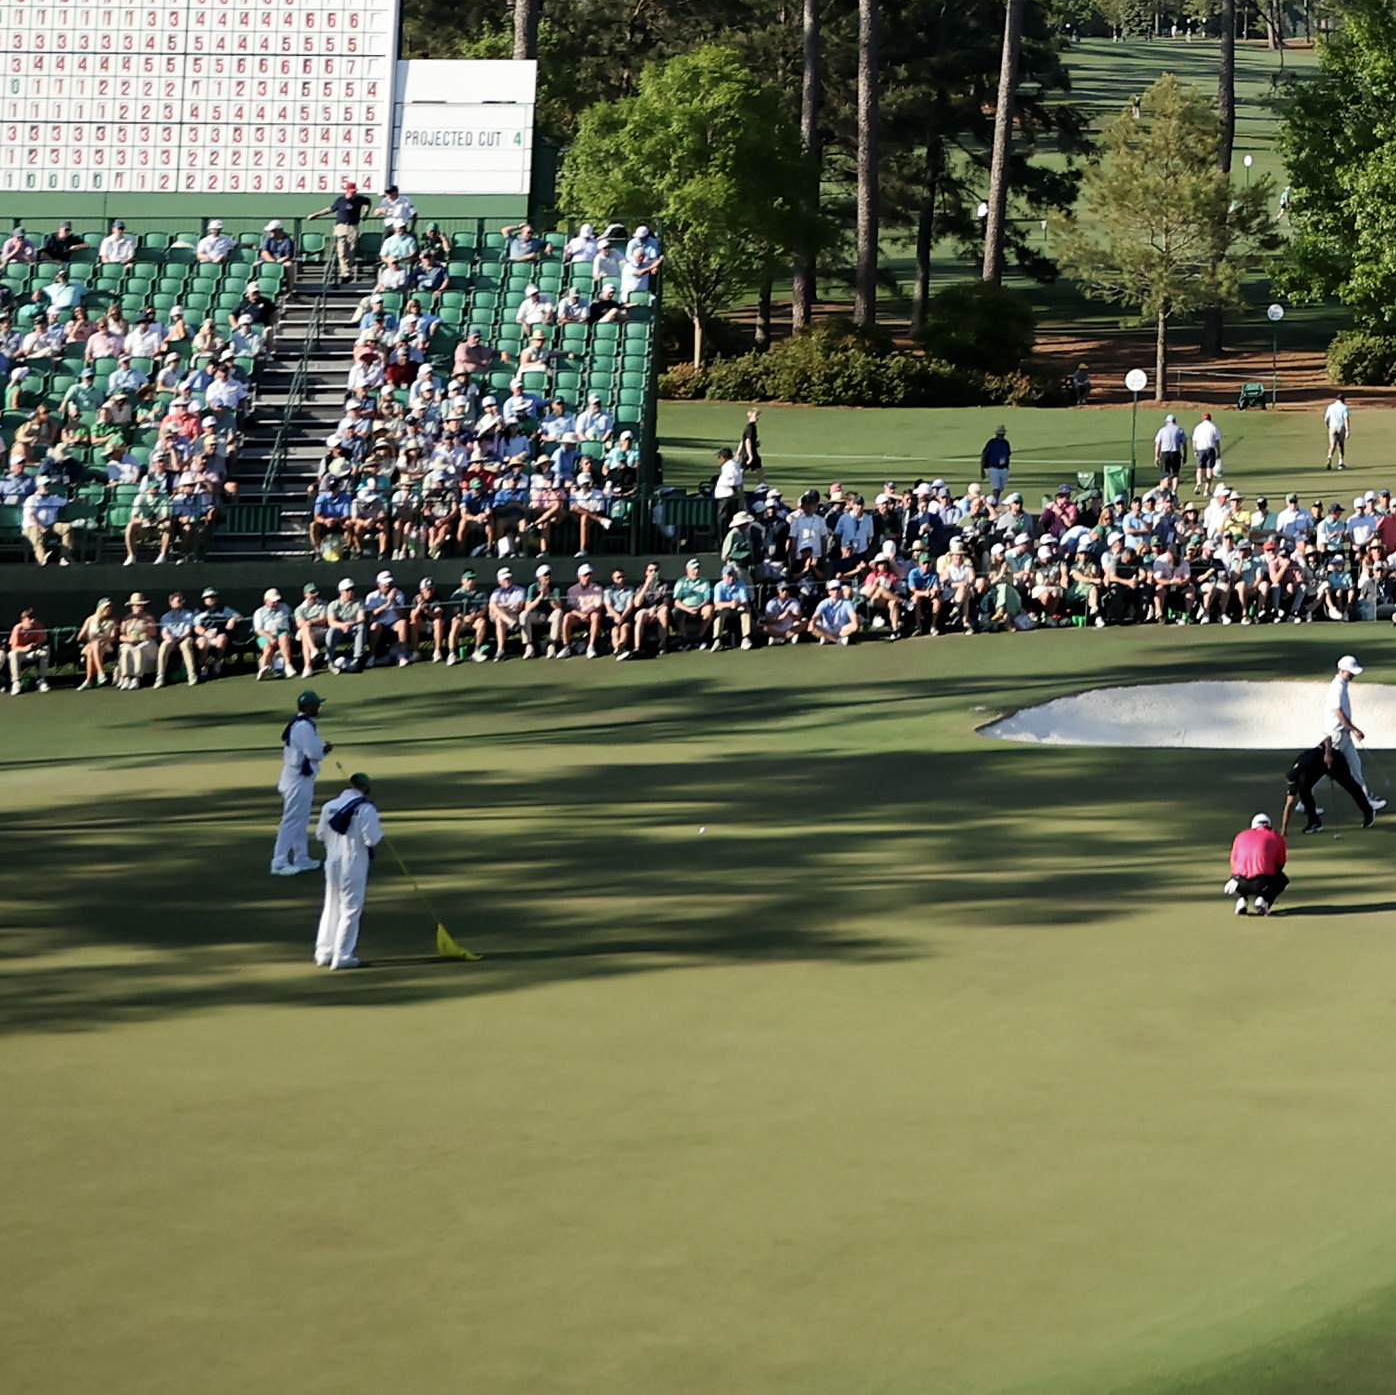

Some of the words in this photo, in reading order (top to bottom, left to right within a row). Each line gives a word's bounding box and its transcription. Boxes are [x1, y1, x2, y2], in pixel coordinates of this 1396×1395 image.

[148, 11, 158, 27] 3
[197, 13, 205, 26] 4
[218, 13, 228, 26] 4
[284, 14, 293, 27] 4
[349, 13, 359, 28] 6
[14, 34, 23, 49] 3
[36, 34, 46, 50] 3
[58, 34, 68, 49] 3
[80, 34, 90, 50] 3
[102, 34, 112, 50] 3
[124, 36, 134, 50] 3
[147, 36, 156, 50] 4
[194, 36, 203, 51] 5
[217, 38, 226, 51] 4
[239, 37, 248, 51] 4
[260, 38, 269, 51] 4
[282, 36, 291, 52] 5
[305, 36, 314, 52] 5
[326, 38, 336, 52] 5
[348, 37, 357, 52] 5
[12, 57, 22, 73] 3
[56, 57, 66, 71] 4
[78, 57, 88, 71] 4
[144, 57, 154, 72] 5
[194, 58, 203, 73] 5
[215, 58, 224, 74] 5
[237, 59, 246, 73] 6
[259, 58, 269, 73] 6
[282, 59, 290, 75] 6
[325, 59, 334, 74] 6
[346, 59, 355, 74] 7
[121, 81, 131, 96] 2
[143, 81, 153, 96] 2
[165, 82, 176, 96] 2
[235, 81, 246, 96] 2
[258, 81, 268, 97] 3
[280, 81, 289, 95] 4
[323, 82, 333, 97] 5
[346, 81, 355, 98] 5
[120, 104, 130, 120] 2
[141, 104, 152, 119] 2
[163, 105, 174, 120] 3
[191, 105, 200, 119] 4
[213, 106, 223, 121] 5
[234, 106, 244, 121] 4
[256, 105, 265, 120] 4
[279, 107, 288, 120] 4
[301, 106, 310, 121] 5
[322, 106, 332, 121] 5
[344, 106, 353, 122] 5
[366, 107, 376, 121] 5
[8, 125, 18, 141] 3
[52, 125, 62, 142] 3
[74, 126, 84, 142] 3
[140, 127, 150, 142] 3
[162, 126, 173, 142] 3
[189, 126, 199, 143] 3
[211, 127, 220, 143] 3
[277, 128, 287, 143] 3
[343, 129, 352, 143] 4
[404, 130, 473, 146] PROJECTED
[478, 131, 502, 146] CUT
[513, 131, 522, 146] 4
[51, 148, 61, 164] 3
[73, 150, 83, 164] 3
[117, 148, 127, 165] 3
[139, 150, 149, 166] 3
[161, 149, 171, 165] 3
[188, 152, 197, 166] 2
[209, 151, 220, 166] 2
[232, 149, 242, 166] 2
[253, 150, 263, 166] 2
[276, 152, 286, 167] 2
[299, 150, 308, 167] 3
[321, 153, 329, 165] 4
[341, 152, 351, 165] 4
[365, 151, 373, 166] 4
[160, 174, 170, 189] 2
[187, 175, 196, 190] 2
[209, 175, 218, 190] 2
[230, 174, 240, 190] 3
[253, 175, 263, 190] 3
[275, 175, 285, 190] 3
[297, 176, 306, 189] 4
[318, 176, 328, 191] 5
[363, 177, 372, 190] 4
